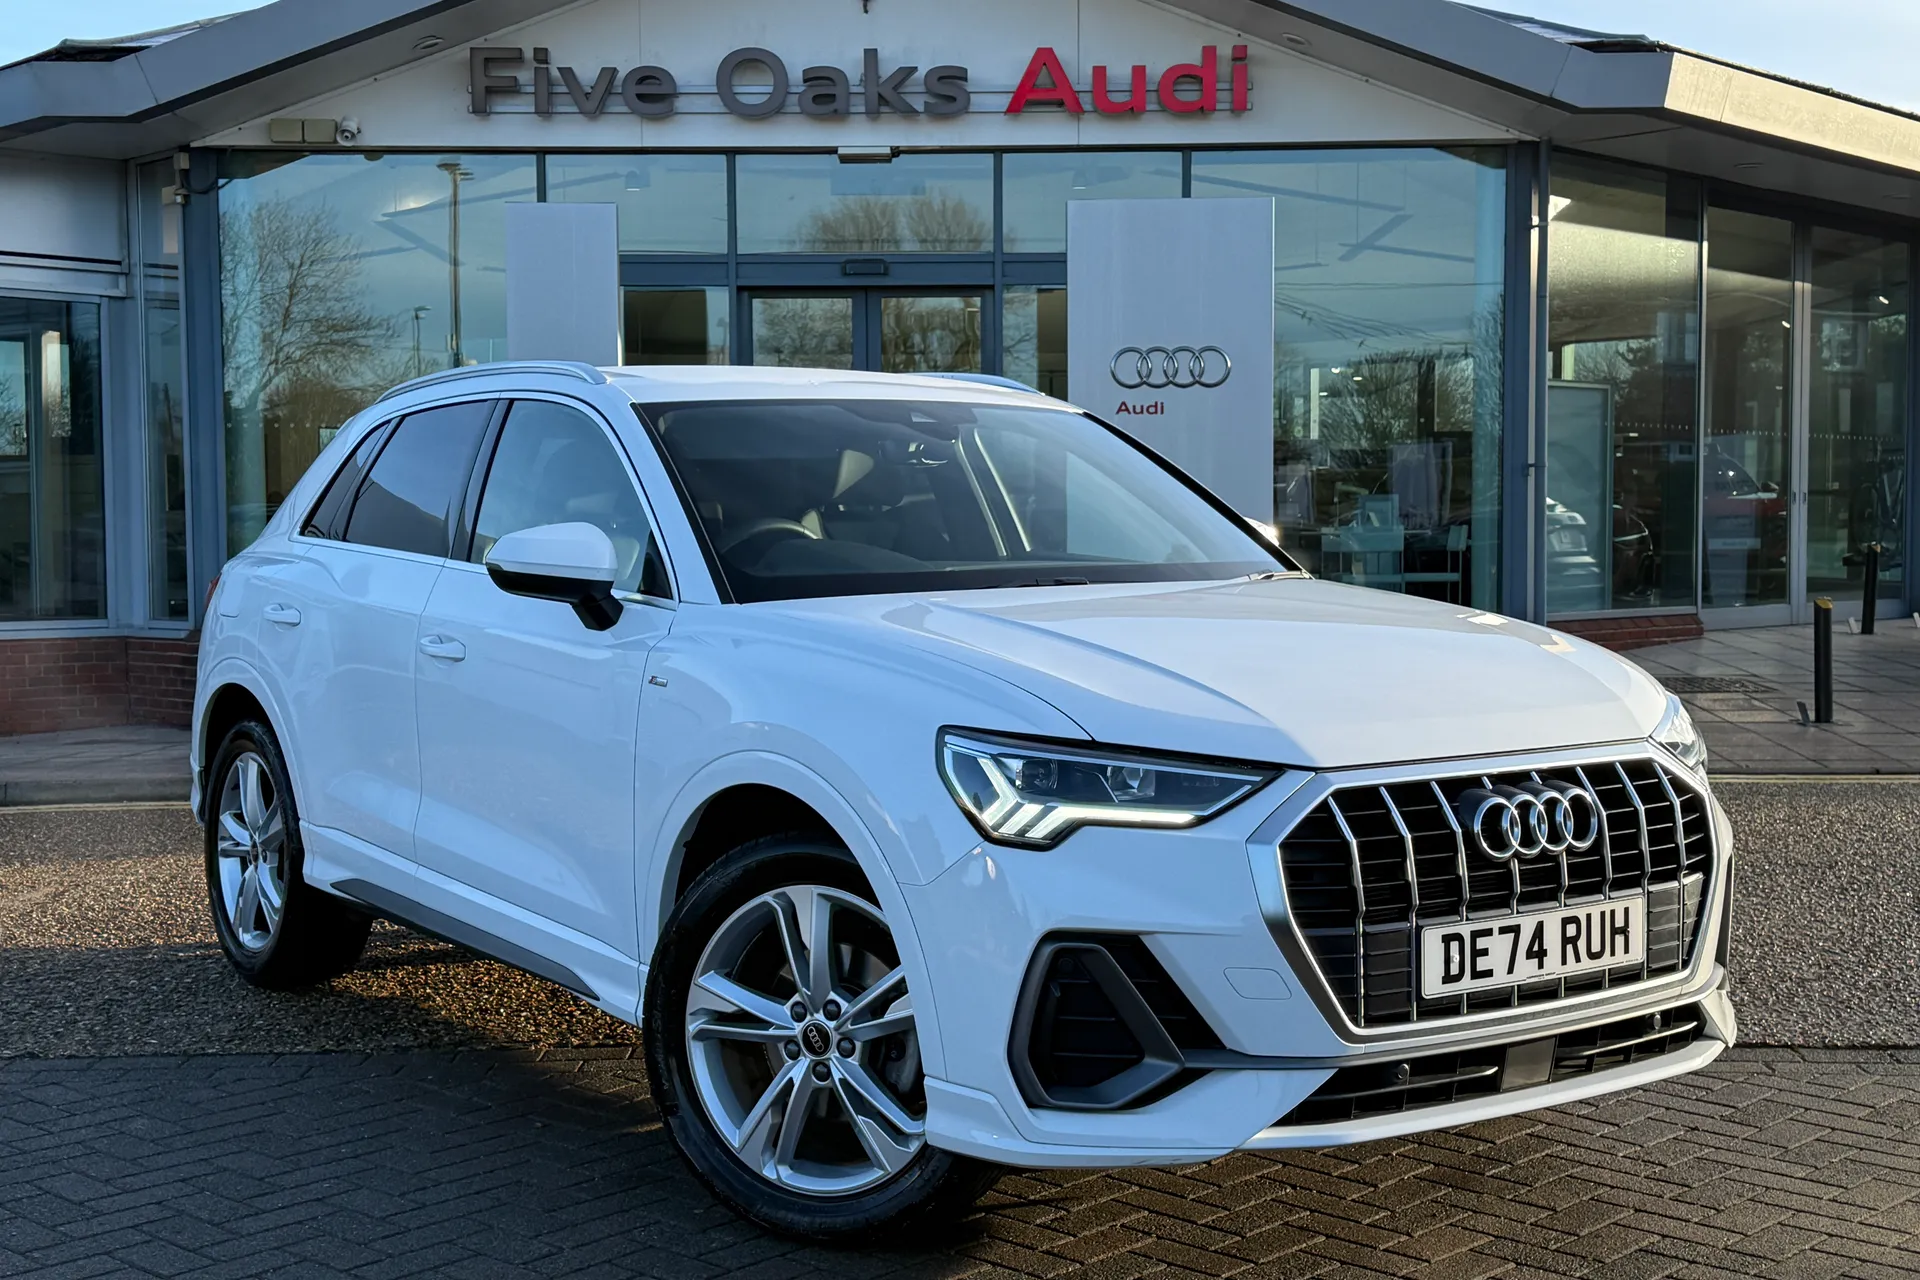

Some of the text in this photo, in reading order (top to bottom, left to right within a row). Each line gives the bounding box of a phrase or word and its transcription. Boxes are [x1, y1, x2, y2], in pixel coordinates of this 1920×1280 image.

[469, 44, 1248, 118] Five Oaks Audi
[1115, 400, 1165, 415] Audi
[1441, 906, 1630, 985] DE74 RUH
